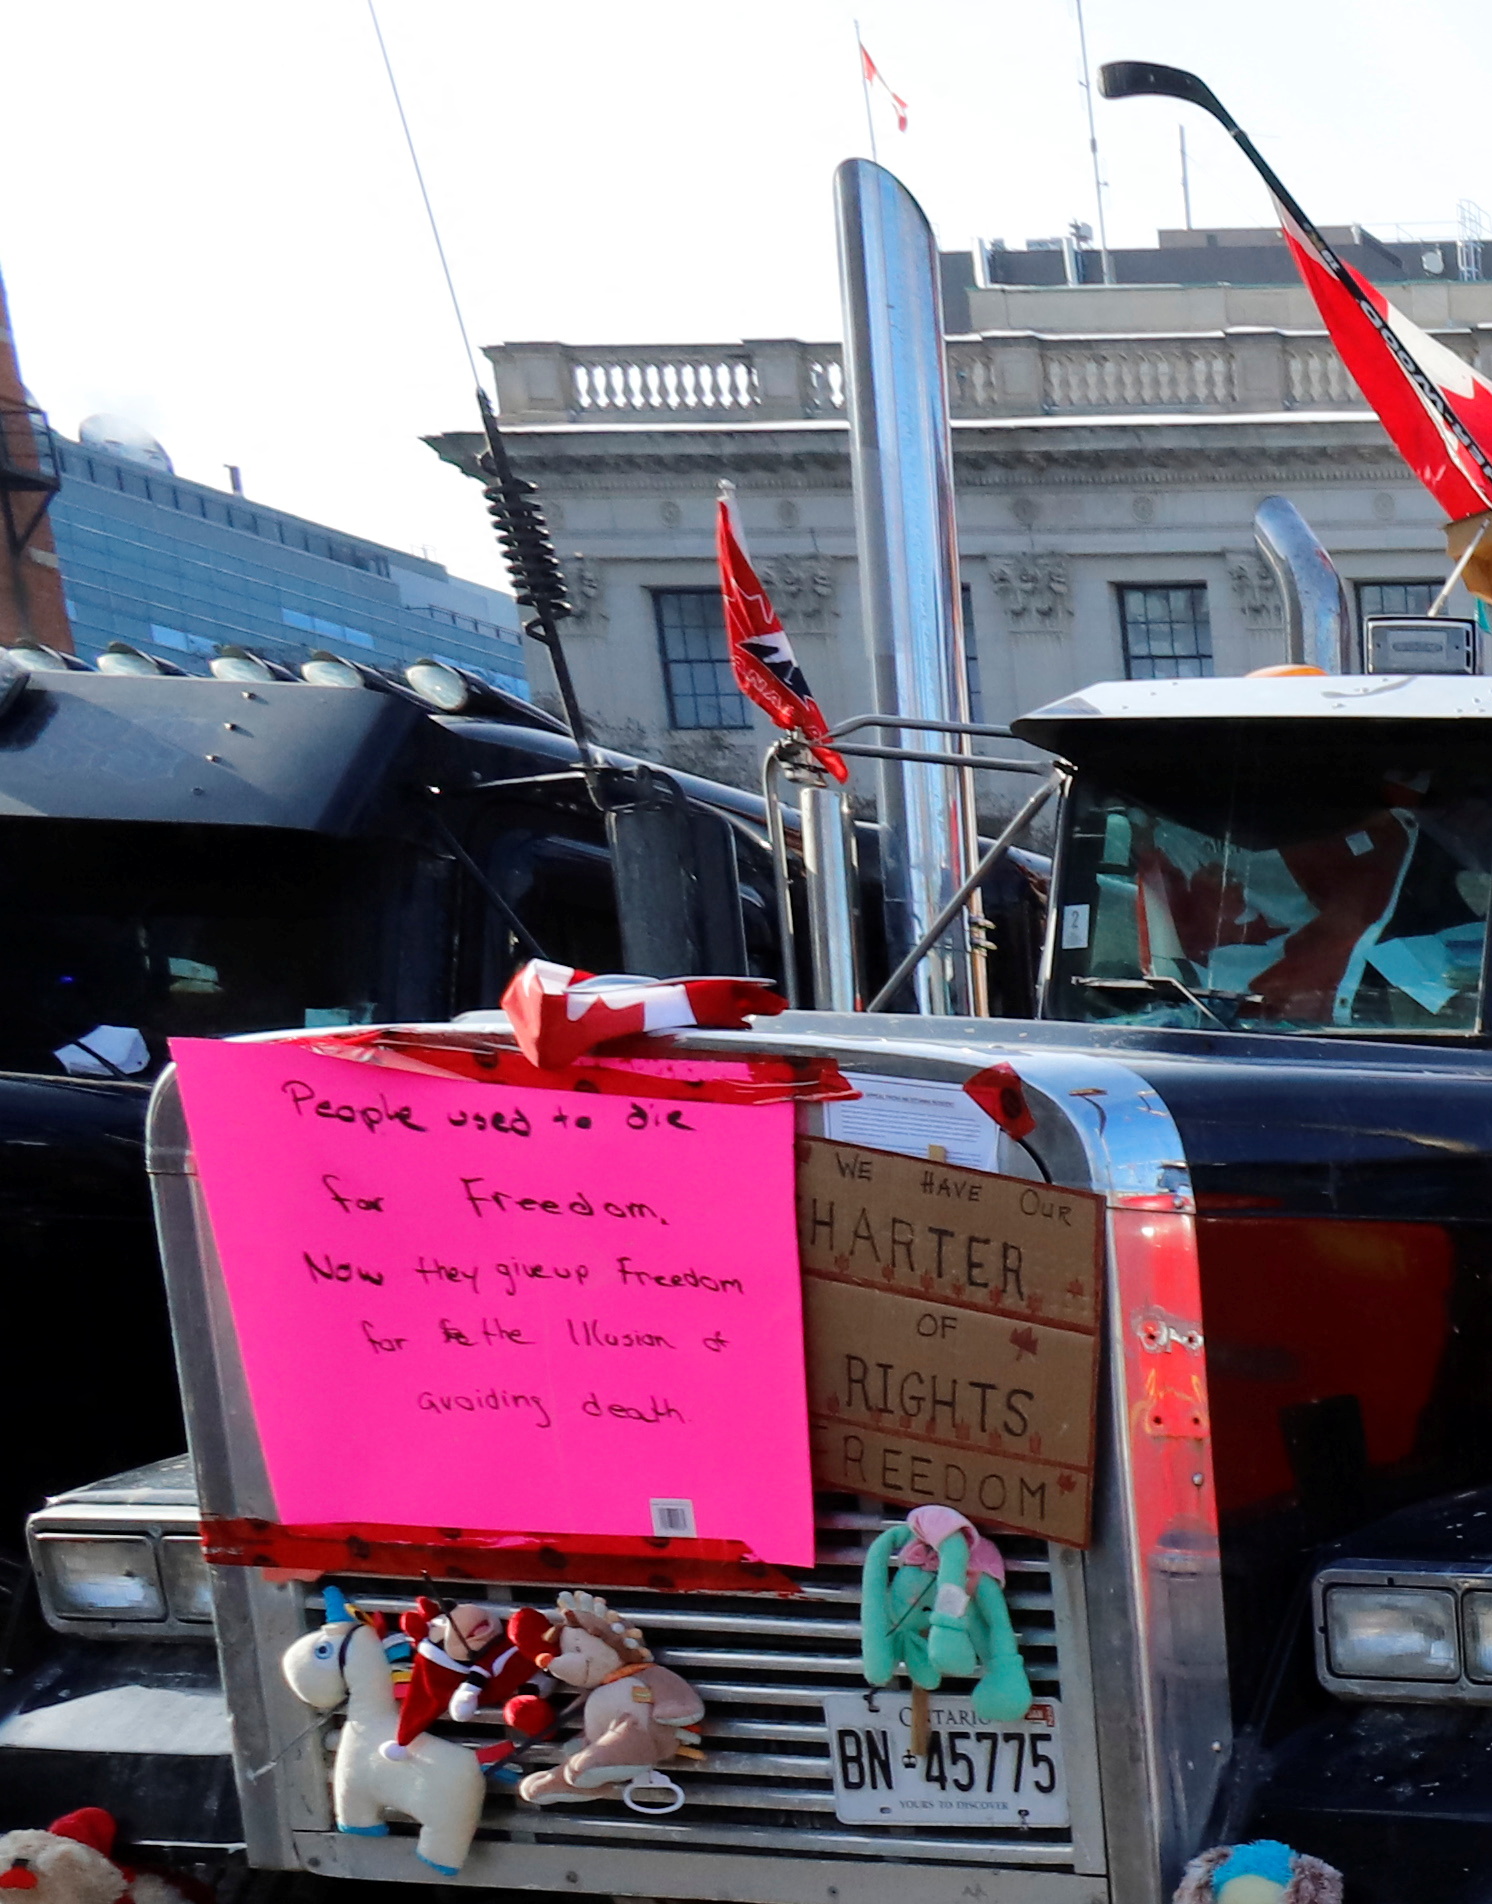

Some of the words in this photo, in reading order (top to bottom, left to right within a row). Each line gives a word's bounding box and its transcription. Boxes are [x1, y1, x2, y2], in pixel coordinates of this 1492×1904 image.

[281, 1080, 426, 1133] People
[448, 1107, 531, 1138] used
[553, 1109, 592, 1131] to
[626, 1103, 696, 1133] die
[322, 1175, 384, 1213] for
[836, 1151, 873, 1181] WE
[921, 1170, 982, 1201] HAVE
[303, 1253, 384, 1286] Now
[414, 1256, 479, 1295] they
[617, 1261, 744, 1295] Freedom
[362, 1322, 408, 1352] for
[481, 1319, 534, 1347] the
[567, 1319, 675, 1351] Illusion
[703, 1331, 729, 1351] of
[916, 1314, 957, 1341] OF
[419, 1391, 551, 1427] avoiding
[845, 1353, 1034, 1438] RIGHTS
[837, 1730, 894, 1789] BN
[925, 1731, 1055, 1794] 45775
[900, 1799, 939, 1810] YOURS
[959, 1800, 1008, 1812] DISCOVER
